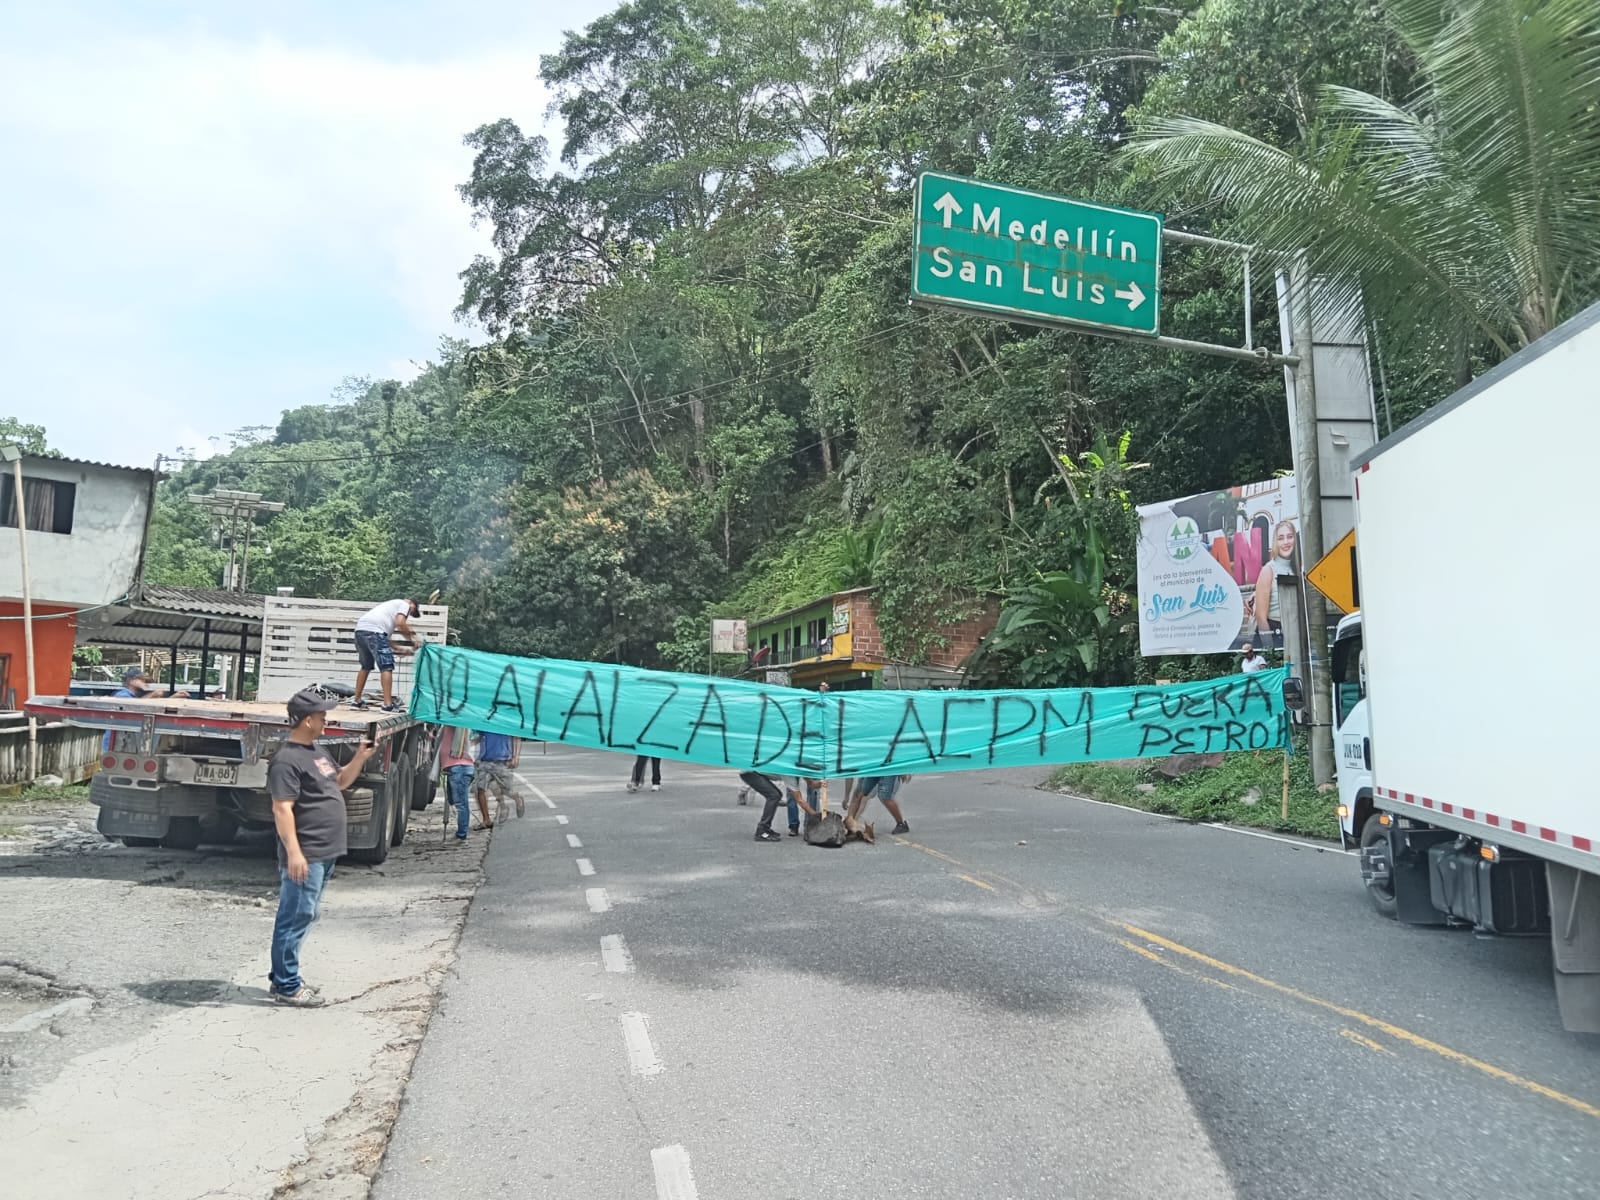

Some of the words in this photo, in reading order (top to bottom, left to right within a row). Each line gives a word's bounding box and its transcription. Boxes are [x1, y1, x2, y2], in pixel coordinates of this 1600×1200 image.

[972, 203, 1137, 263] Medellín
[929, 246, 1003, 287] San
[1023, 261, 1105, 305] Luis
[1167, 578, 1195, 586] municipio
[1179, 568, 1212, 577] bienvenida
[1146, 593, 1184, 622] San
[1190, 583, 1228, 612] Luis
[412, 644, 470, 720] NO
[560, 670, 729, 764] ALZA
[752, 692, 859, 774] DEL
[880, 691, 1093, 767] ACPM
[1127, 676, 1273, 720] FUERA
